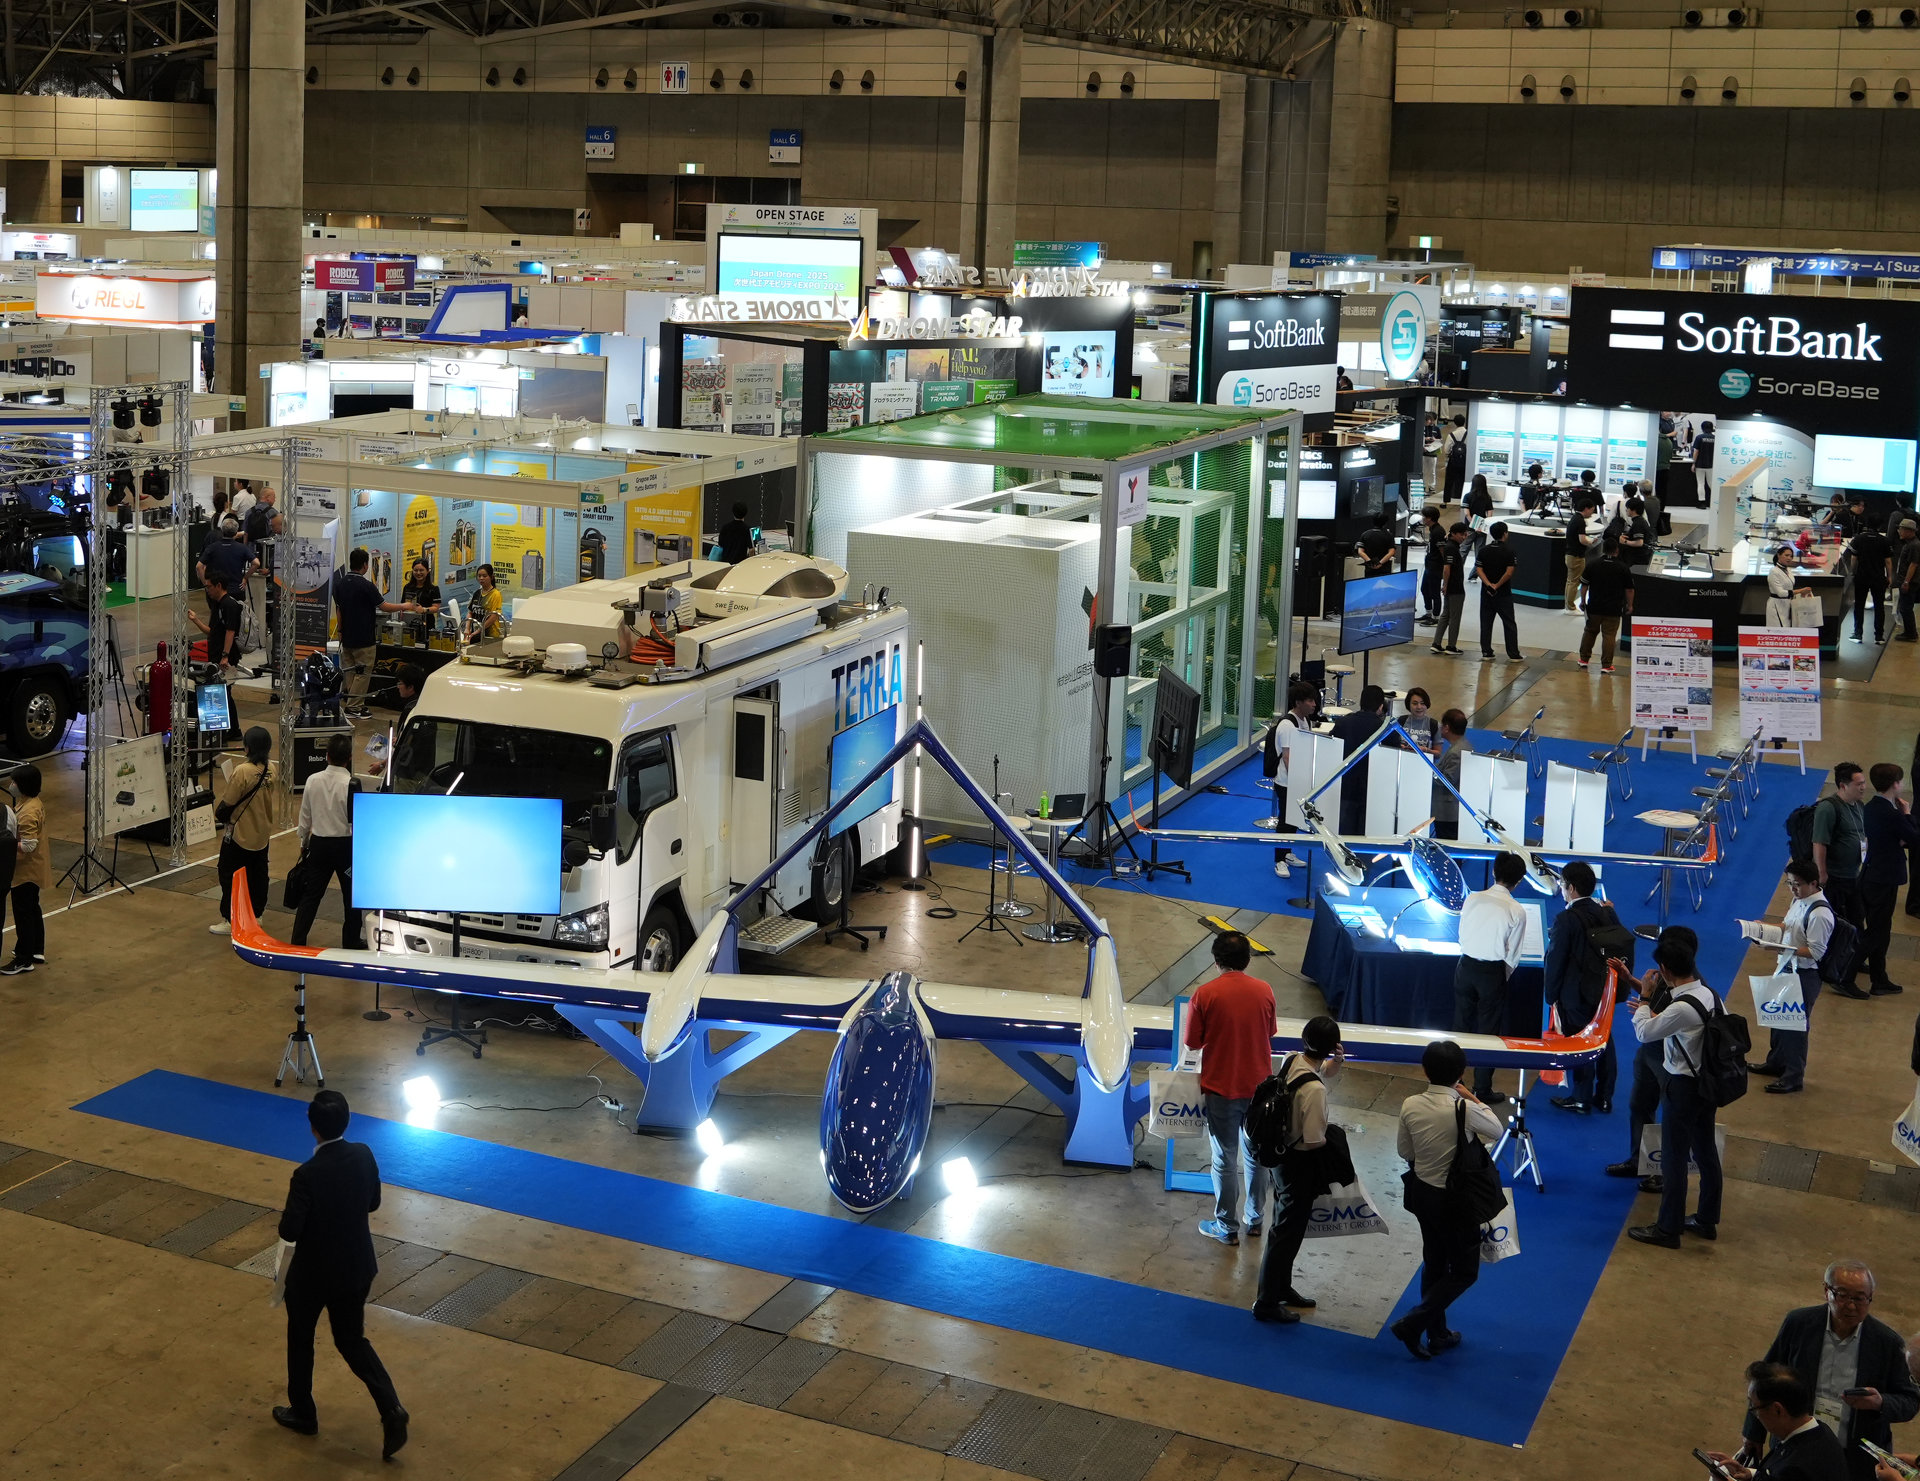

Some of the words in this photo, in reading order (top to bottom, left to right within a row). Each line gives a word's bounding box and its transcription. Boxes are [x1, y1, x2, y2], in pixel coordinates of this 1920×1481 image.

[603, 130, 610, 141] 6
[789, 134, 796, 144] 6
[756, 209, 786, 221] OPEN
[789, 210, 825, 221] STAGE
[749, 269, 774, 279] Japan
[776, 270, 803, 279] Drone
[807, 271, 828, 280] 2025
[733, 278, 821, 290] 次世代エアモビリティEXPO
[823, 281, 845, 291] 2025
[1030, 281, 1087, 298] DRONE
[1089, 281, 1130, 297] STAR
[95, 289, 147, 310] RIEGL
[1340, 305, 1378, 317] 電通総研
[876, 316, 960, 339] DRONE
[962, 314, 1024, 338] STAR
[1253, 318, 1326, 350] SoftBank
[1676, 311, 1883, 362] SoftBank
[951, 361, 969, 377] Help
[969, 364, 988, 376] you?
[1255, 381, 1321, 403] SoraBase
[1757, 377, 1880, 401] SoraBase
[930, 395, 960, 403] TRAINING
[984, 393, 1007, 401] PILOT
[1720, 446, 1798, 460] 空をもっと身近に。
[414, 509, 428, 520] 4.45V
[656, 508, 673, 516] SMART
[493, 567, 517, 575] INDUSTRIAL
[1698, 588, 1729, 597] SoftBank
[733, 604, 749, 612] DISH
[832, 643, 903, 731] TERRA
[1156, 1118, 1194, 1127] INTERNET
[1309, 1203, 1378, 1223] GMO
[1307, 1221, 1348, 1233] INTERNET
[1348, 1219, 1381, 1230] GROUP
